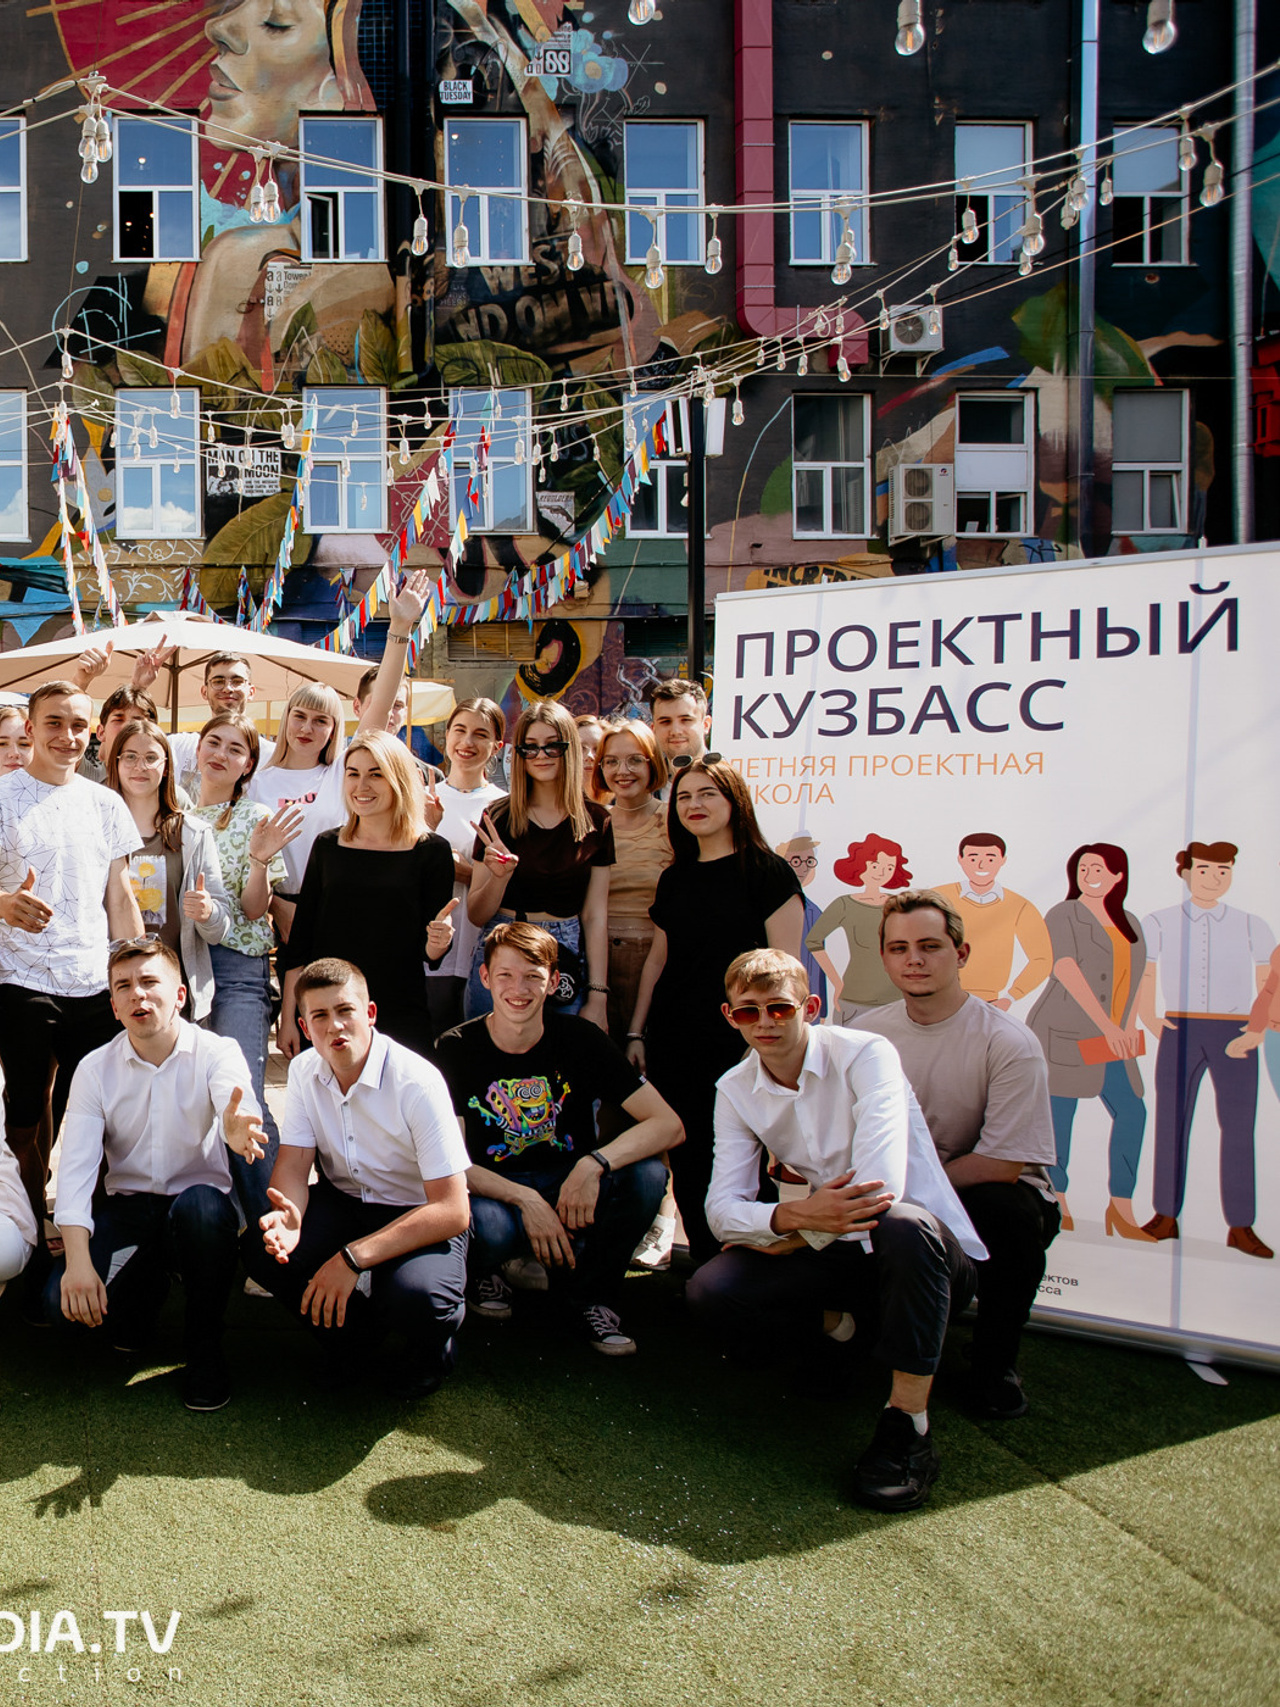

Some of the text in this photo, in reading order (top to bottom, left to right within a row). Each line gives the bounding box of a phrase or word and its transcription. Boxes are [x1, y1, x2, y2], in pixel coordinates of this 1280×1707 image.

[443, 81, 468, 91] BLACK
[440, 91, 472, 101] TUESDAY
[208, 449, 235, 464] MAN
[258, 449, 279, 464] THE
[244, 464, 279, 478] MOON
[735, 581, 1240, 679] ПРОЕКТНЫЙ
[732, 679, 1067, 740] КУЗБАСС
[847, 752, 1044, 777] ПРОЕКТНАЯ
[747, 783, 835, 805] КОЛА
[1042, 1274, 1079, 1287] ектов
